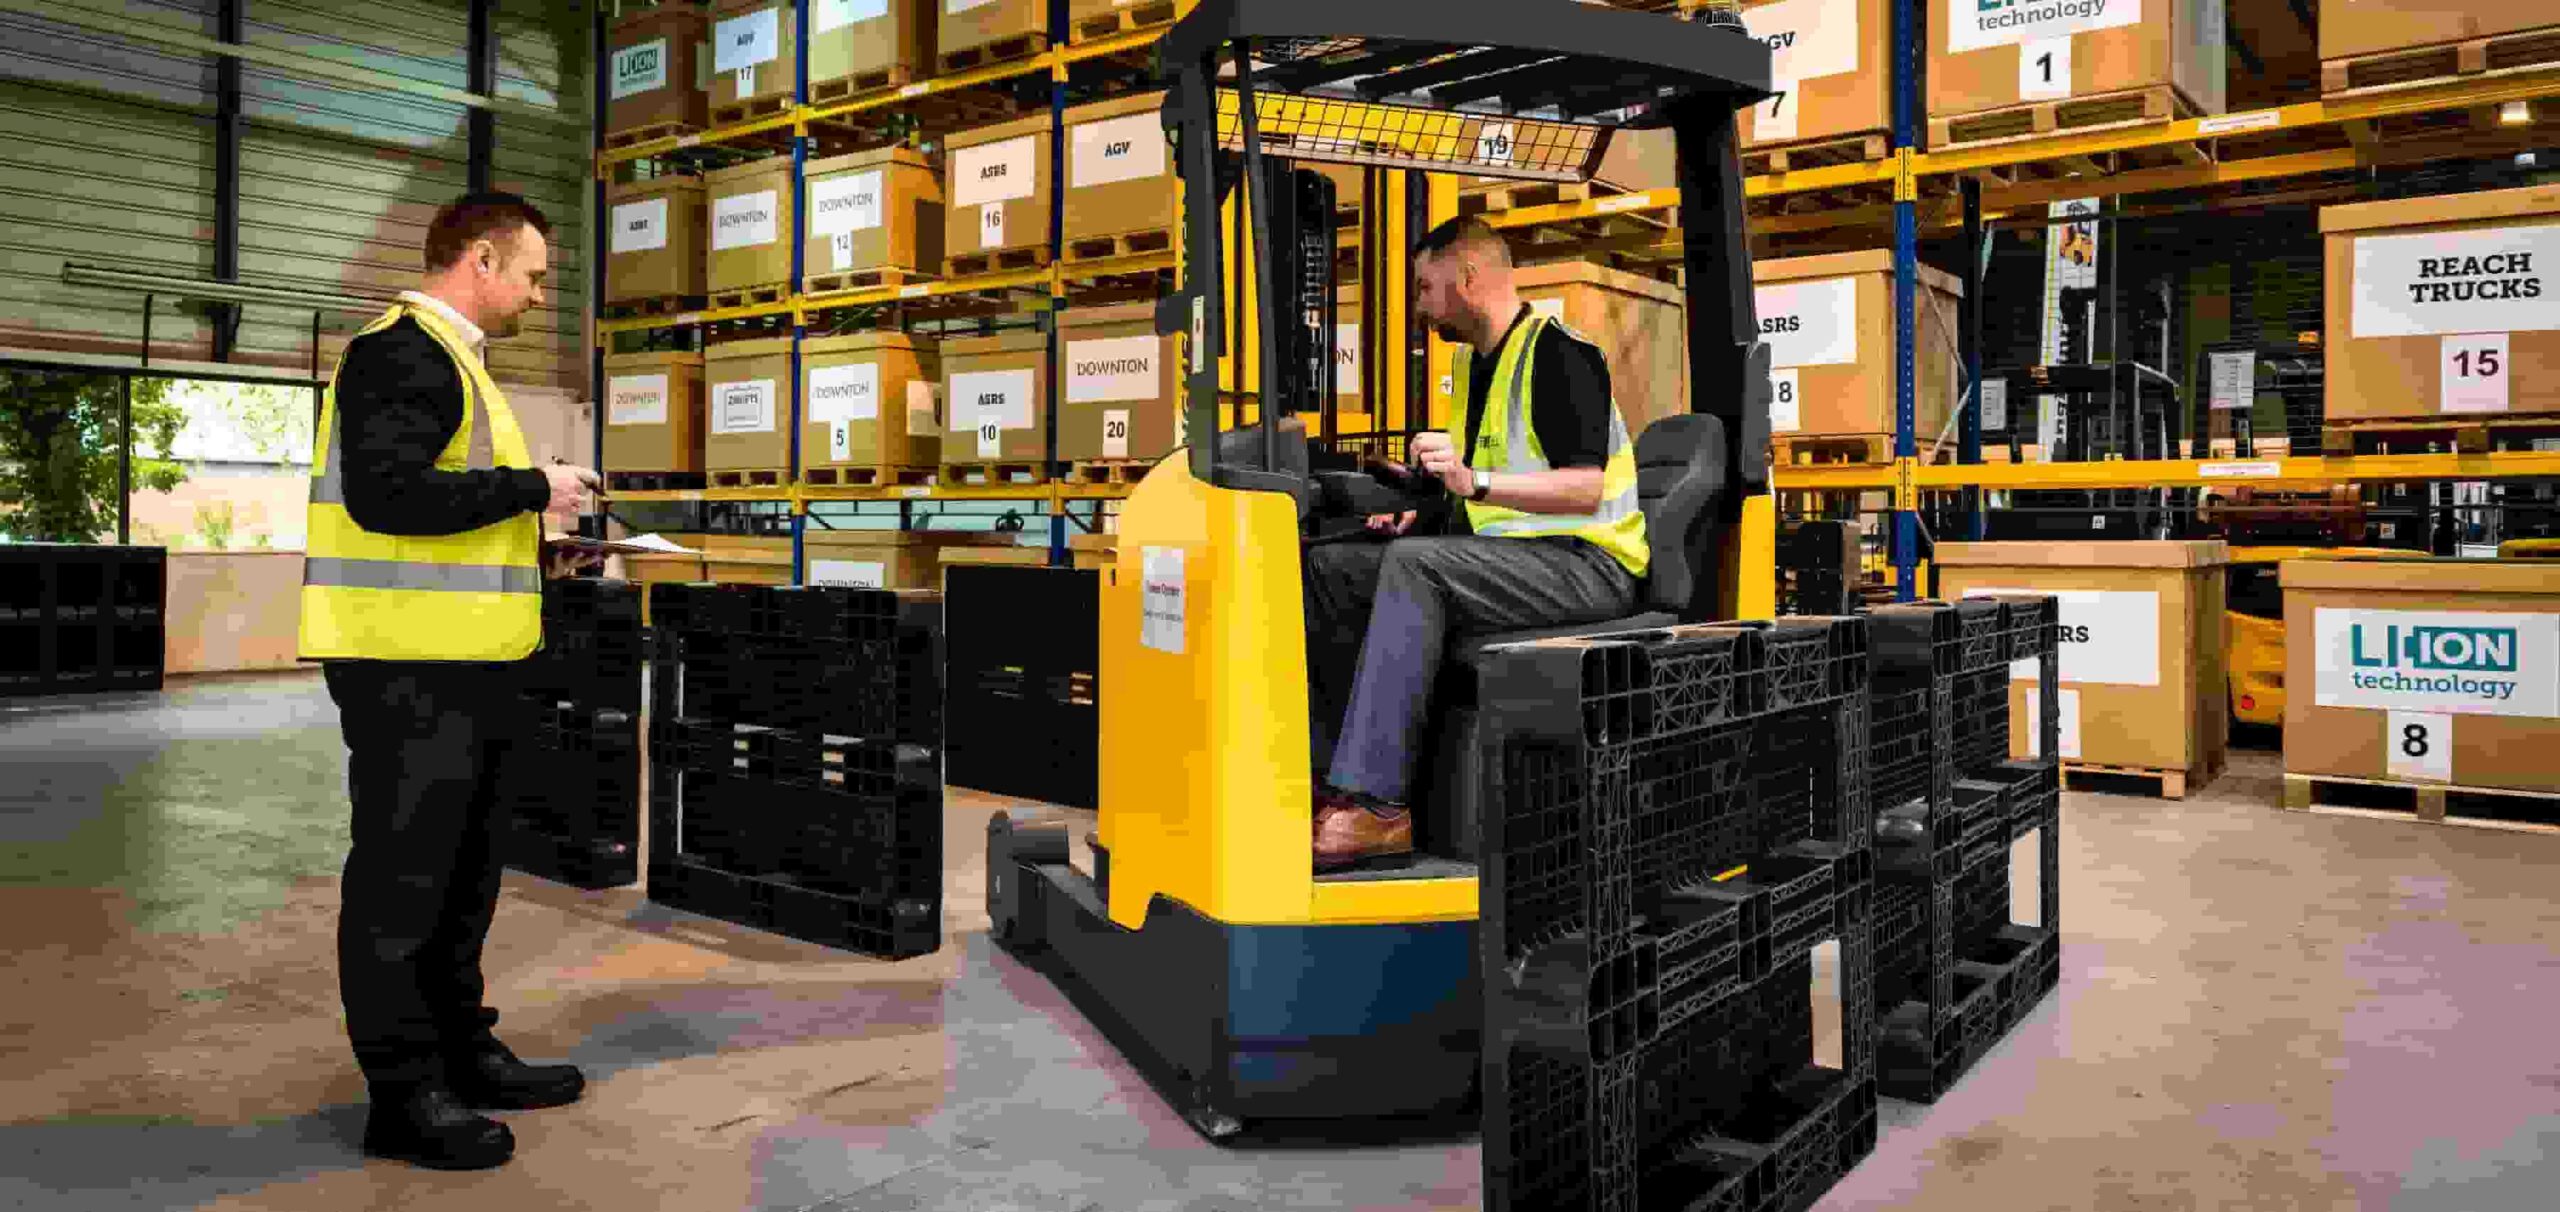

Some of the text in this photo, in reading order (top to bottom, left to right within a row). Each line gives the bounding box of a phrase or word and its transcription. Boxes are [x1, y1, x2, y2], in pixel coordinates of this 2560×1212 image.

[1977, 1, 2106, 31] technology
[1757, 31, 1796, 50] GV
[2036, 51, 2054, 82] 1
[1104, 141, 1131, 158] AGV
[1485, 135, 1507, 159] 19
[986, 210, 1001, 228] 16
[837, 234, 849, 250] 12
[2418, 252, 2532, 278] REACH
[2408, 278, 2542, 303] TRUCKS
[1758, 315, 1800, 334] SRS
[1076, 358, 1148, 376] DOWNTON
[2452, 349, 2500, 377] 15
[836, 429, 845, 446] 5
[980, 424, 997, 441] 10
[1106, 421, 1125, 439] 20
[2058, 625, 2090, 643] RS
[2351, 671, 2518, 700] technology
[2402, 724, 2429, 757] 8
